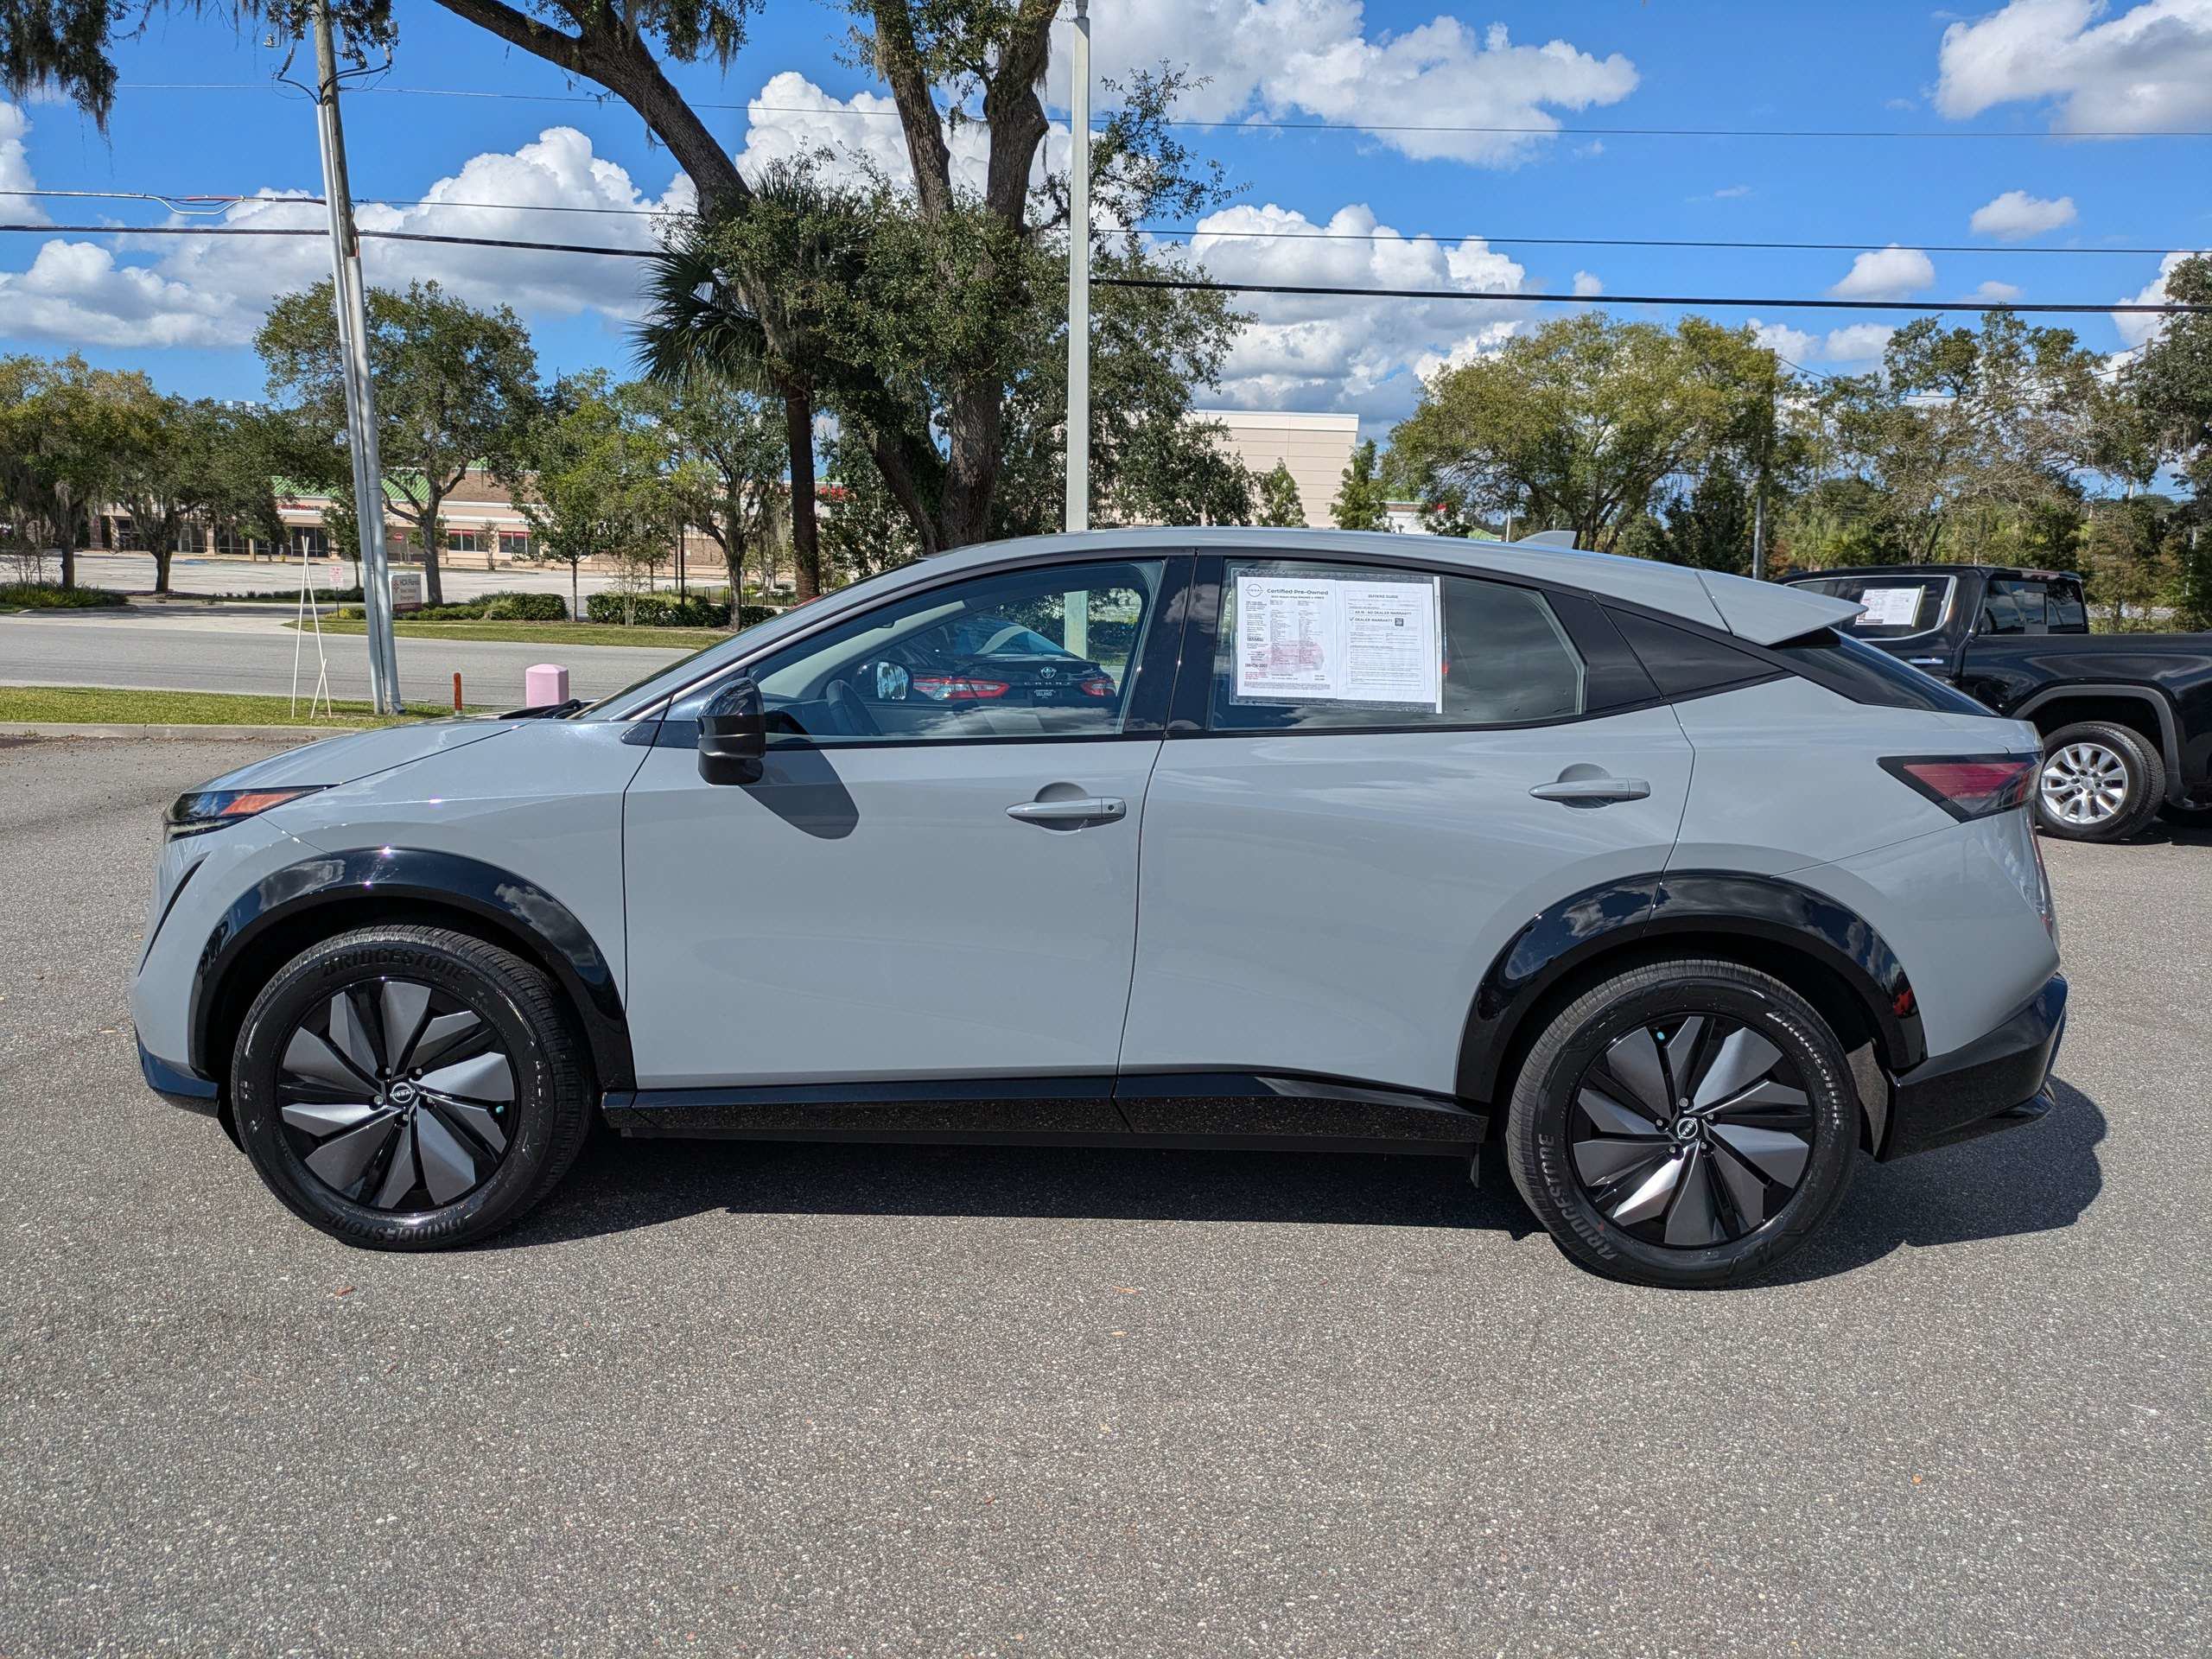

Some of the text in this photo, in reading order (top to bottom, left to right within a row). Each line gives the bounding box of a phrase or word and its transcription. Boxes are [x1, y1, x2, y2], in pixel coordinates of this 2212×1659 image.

[321, 948, 471, 981] BRIDGESTONE
[390, 1088, 416, 1098] NISSAN
[1538, 1133, 1619, 1261] BRIDGESTONE
